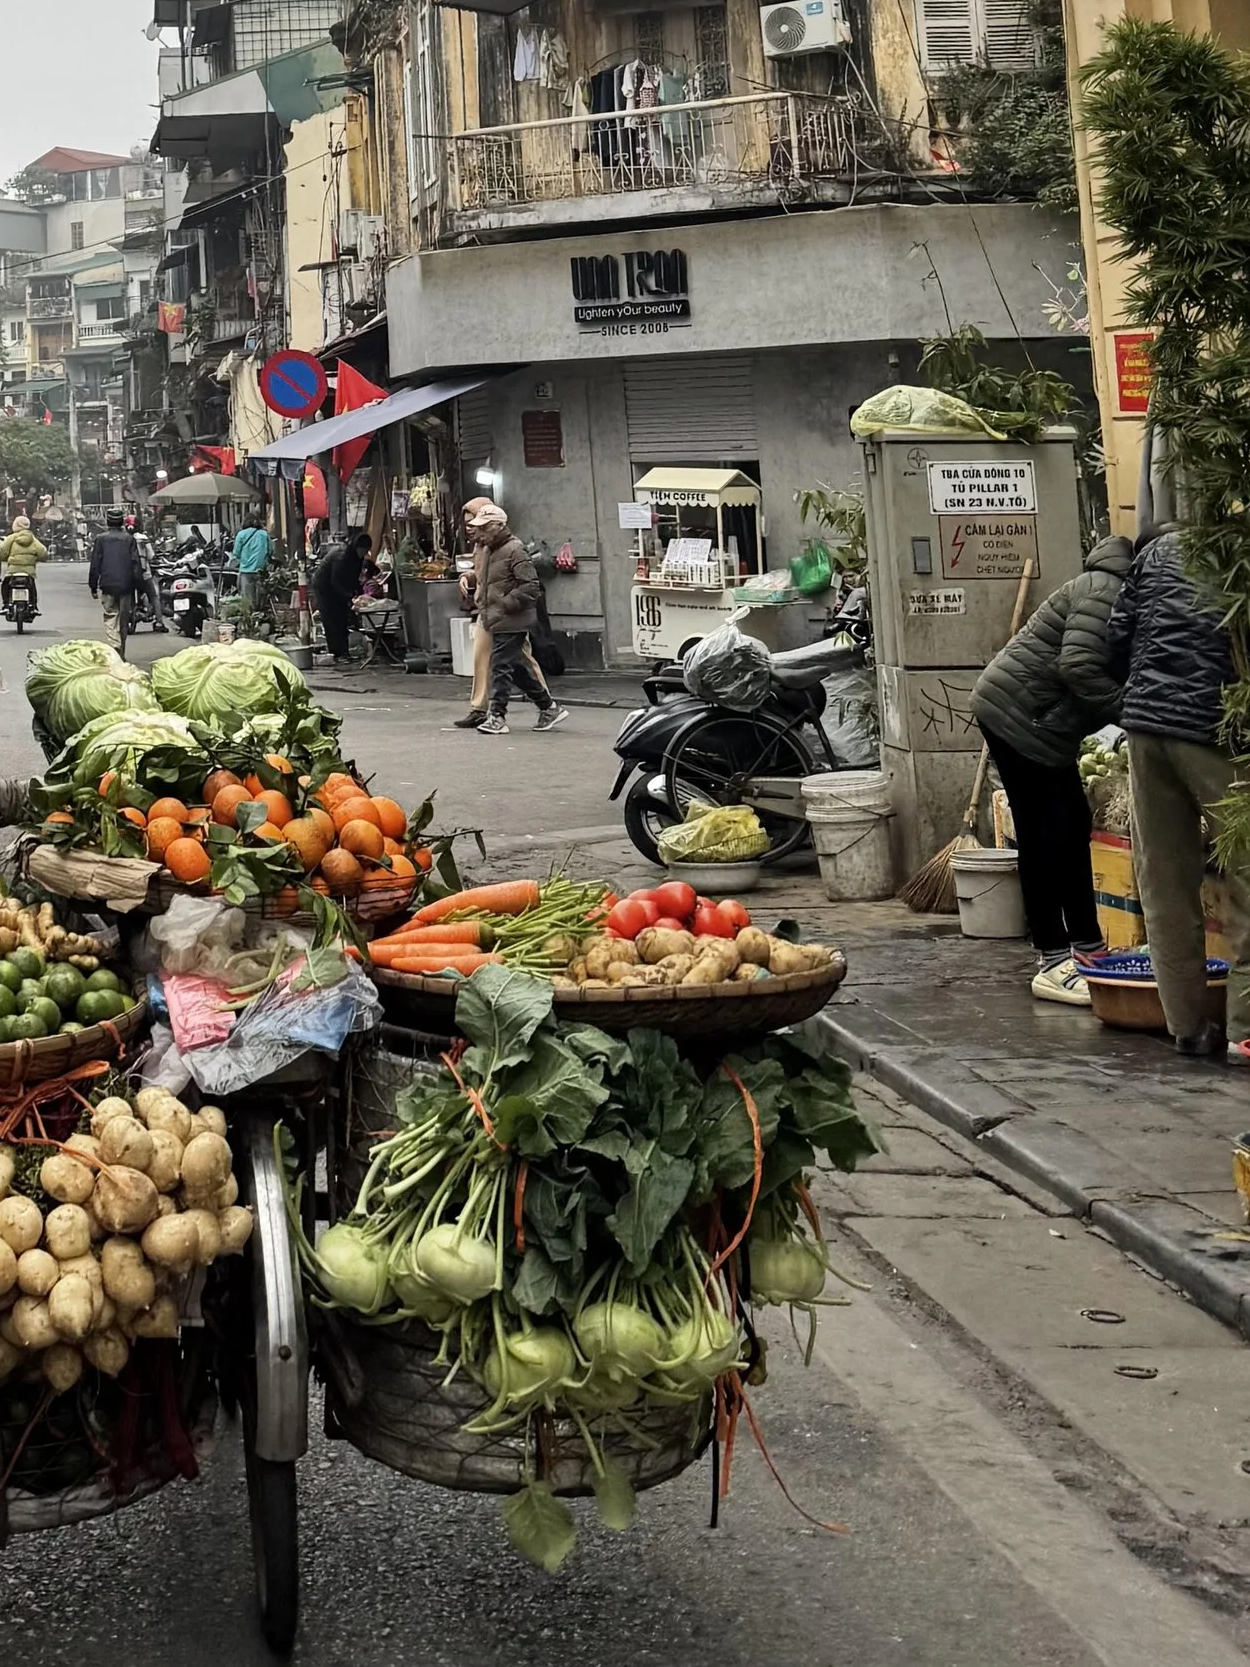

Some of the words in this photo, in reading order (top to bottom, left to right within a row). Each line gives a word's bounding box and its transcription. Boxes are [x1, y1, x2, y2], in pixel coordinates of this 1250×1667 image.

[644, 303, 682, 314] beauty
[601, 325, 637, 336] SINCE
[1015, 469, 1025, 478] 10
[969, 483, 1009, 493] PILLAR
[1013, 483, 1018, 492] 1
[672, 492, 707, 502] COFFEE
[945, 498, 965, 509] (SN
[968, 498, 983, 507] 23
